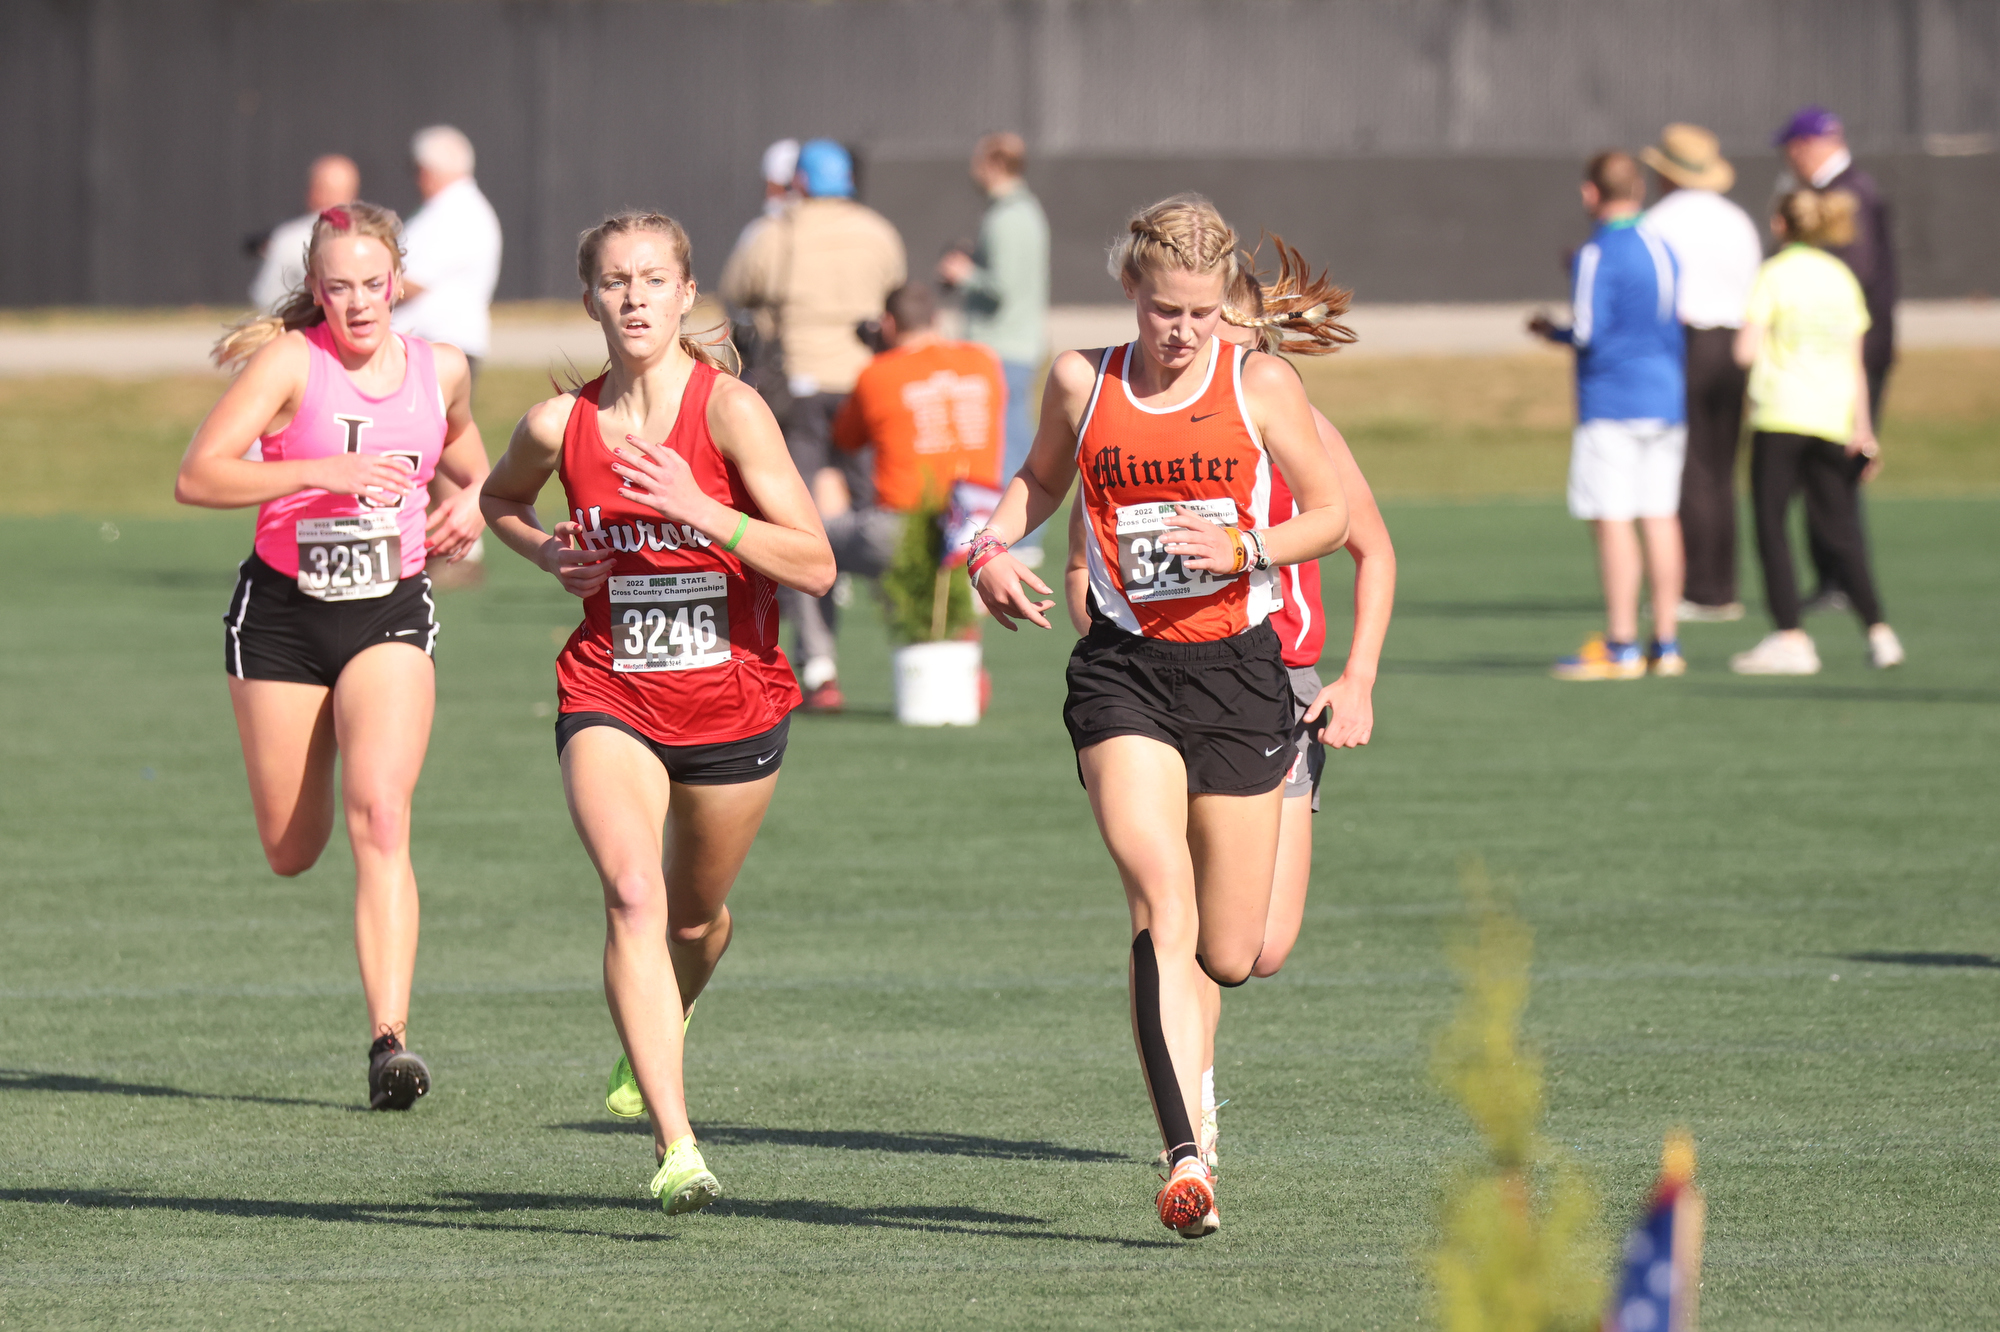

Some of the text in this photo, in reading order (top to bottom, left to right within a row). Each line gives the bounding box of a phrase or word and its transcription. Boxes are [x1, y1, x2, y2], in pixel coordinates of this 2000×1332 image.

[1093, 445, 1239, 490] Minster
[1118, 519, 1140, 527] Cross
[1134, 508, 1153, 516] 2022
[575, 505, 713, 553] Huron
[309, 539, 391, 589] 3251
[611, 584, 724, 598] Cross Country Championships
[626, 576, 707, 587] 2022 OHSAA STATE
[622, 604, 718, 656] 3246
